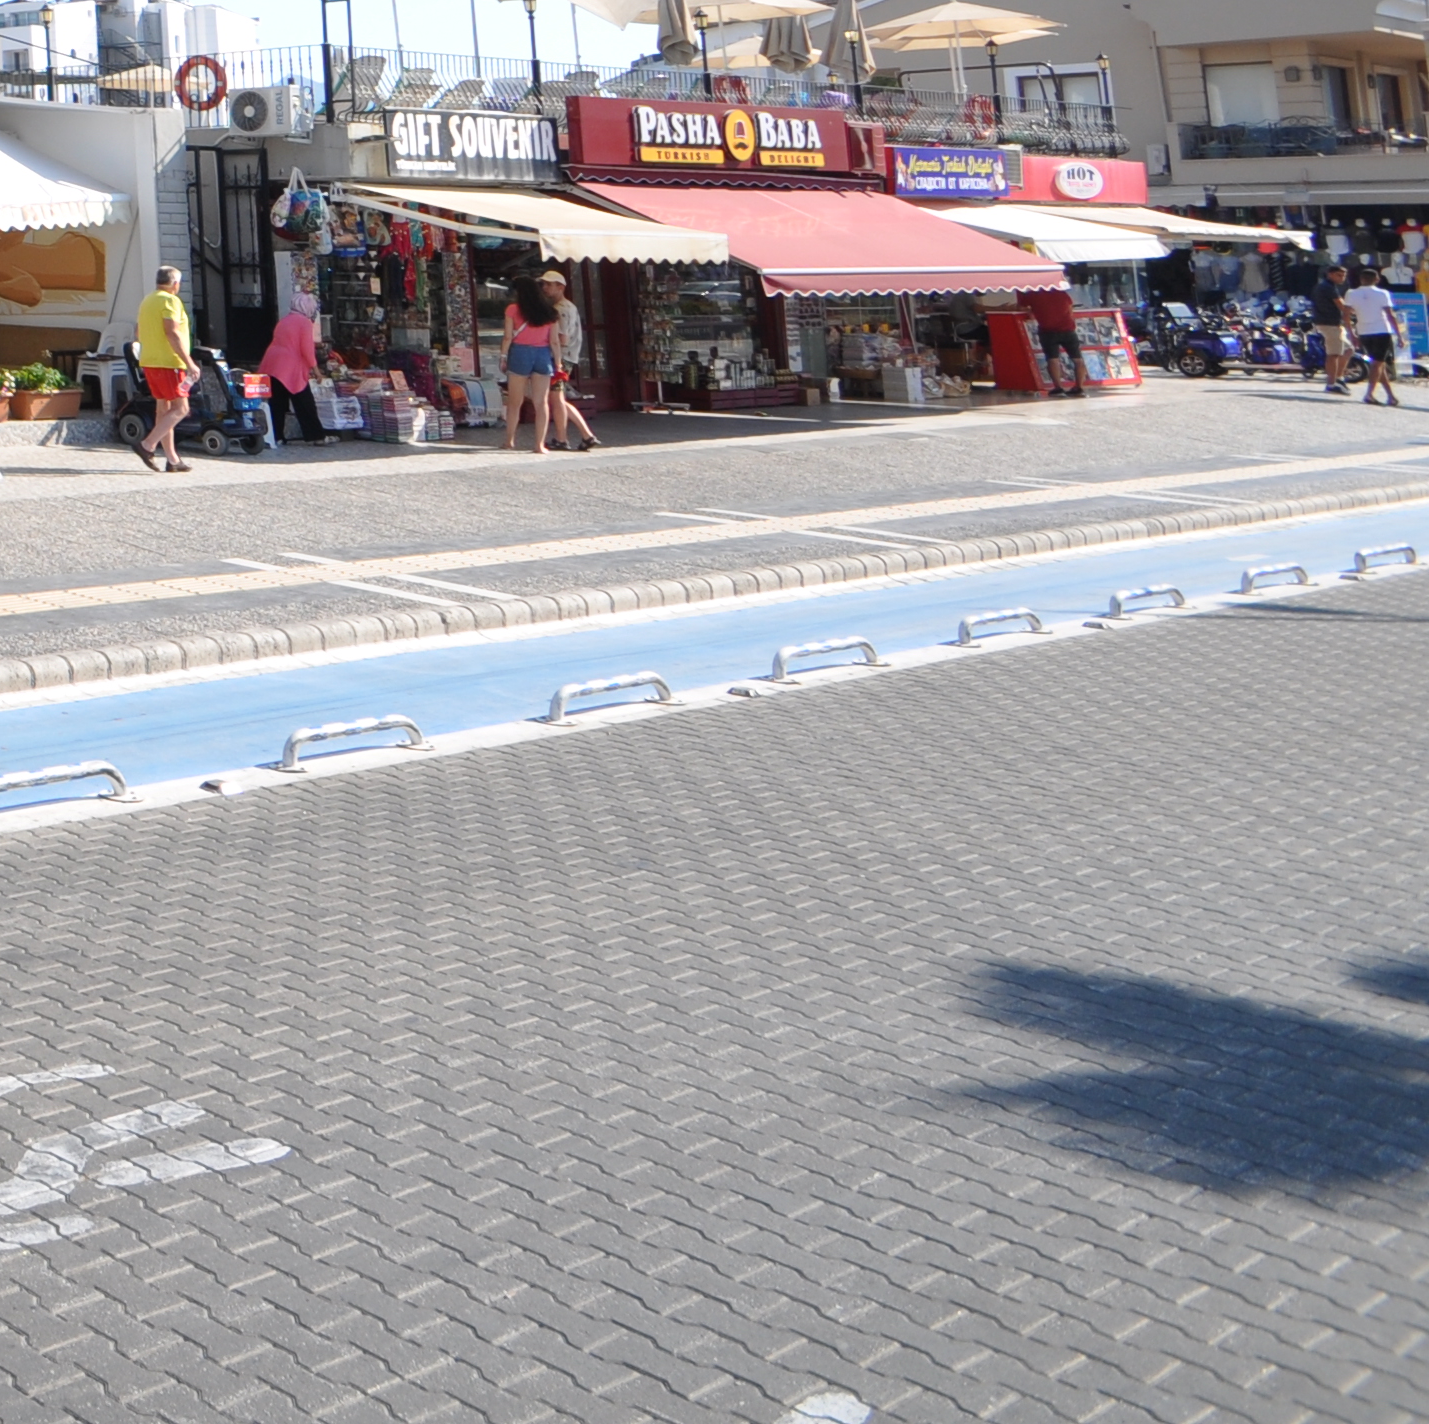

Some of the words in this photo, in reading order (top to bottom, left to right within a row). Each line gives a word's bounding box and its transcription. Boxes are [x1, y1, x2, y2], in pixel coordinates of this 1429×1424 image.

[275, 90, 284, 125] REGAL
[635, 105, 722, 145] PASHA
[756, 111, 822, 150] BABA
[392, 112, 441, 157] GIFT
[448, 115, 557, 162] SOUVENIR
[656, 150, 710, 161] TURKISH
[769, 154, 816, 164] DELIGHT
